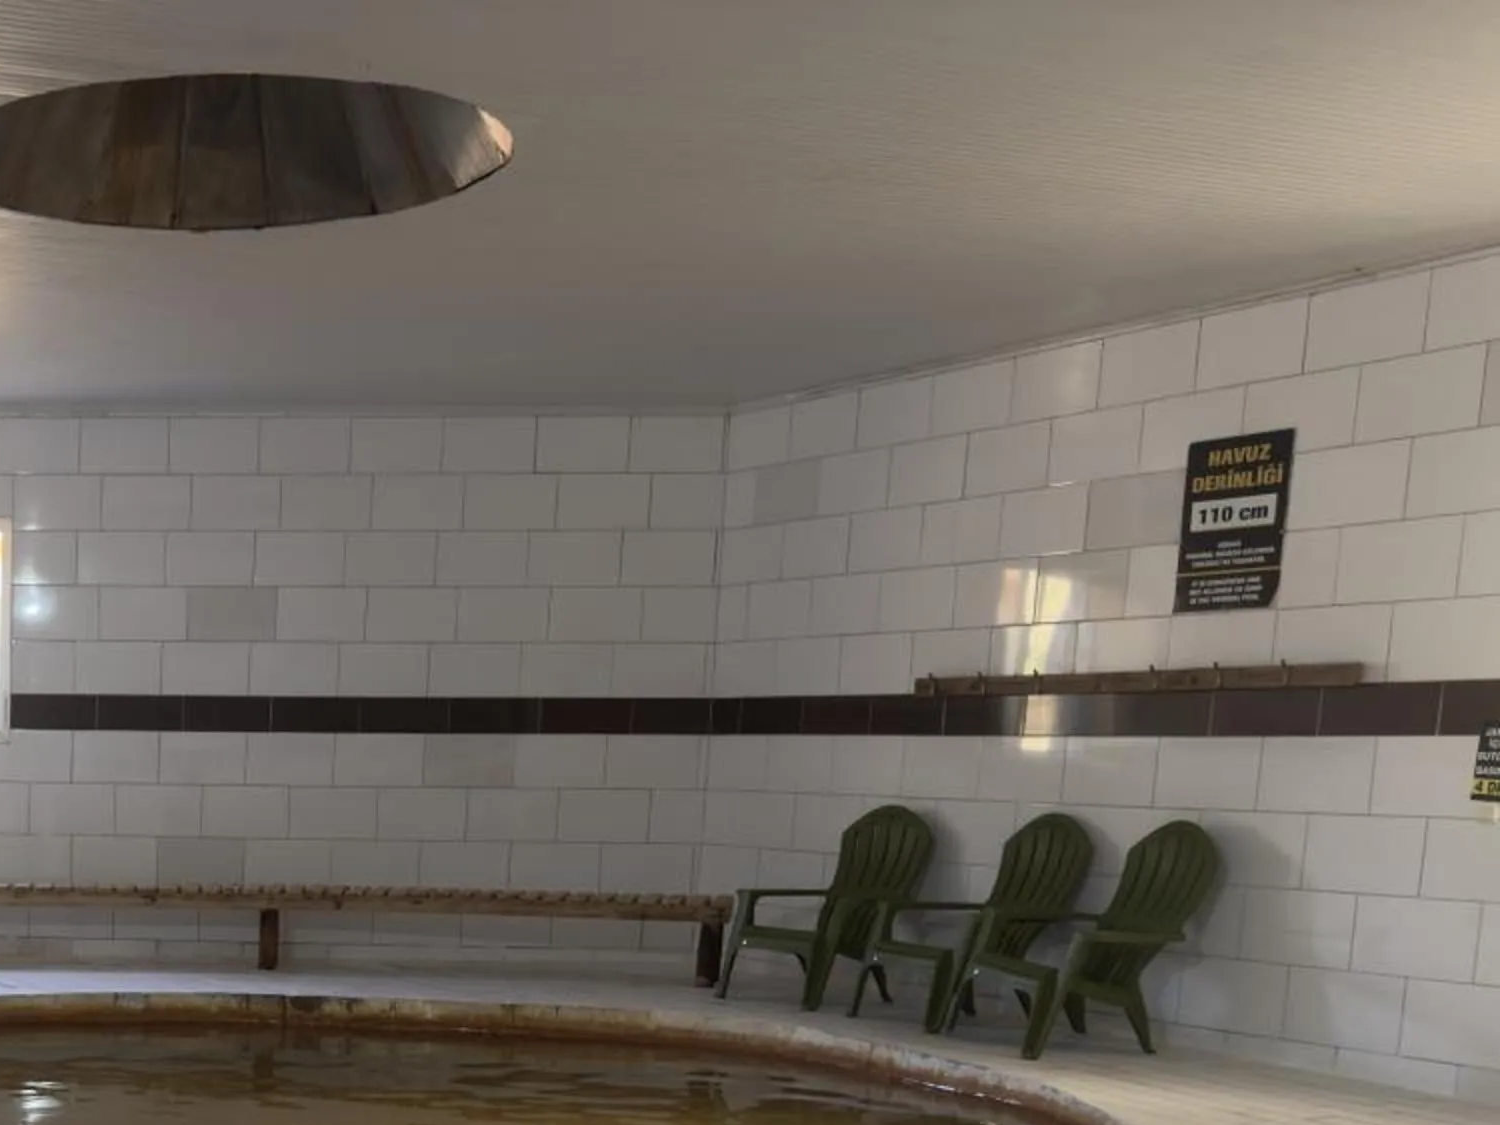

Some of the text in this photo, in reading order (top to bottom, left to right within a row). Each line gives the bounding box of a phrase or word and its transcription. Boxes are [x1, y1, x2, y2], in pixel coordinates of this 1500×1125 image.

[1208, 443, 1272, 467] HAVUZ
[1192, 463, 1284, 493] DERİNLİĞİ
[1199, 505, 1269, 524] 110 cm
